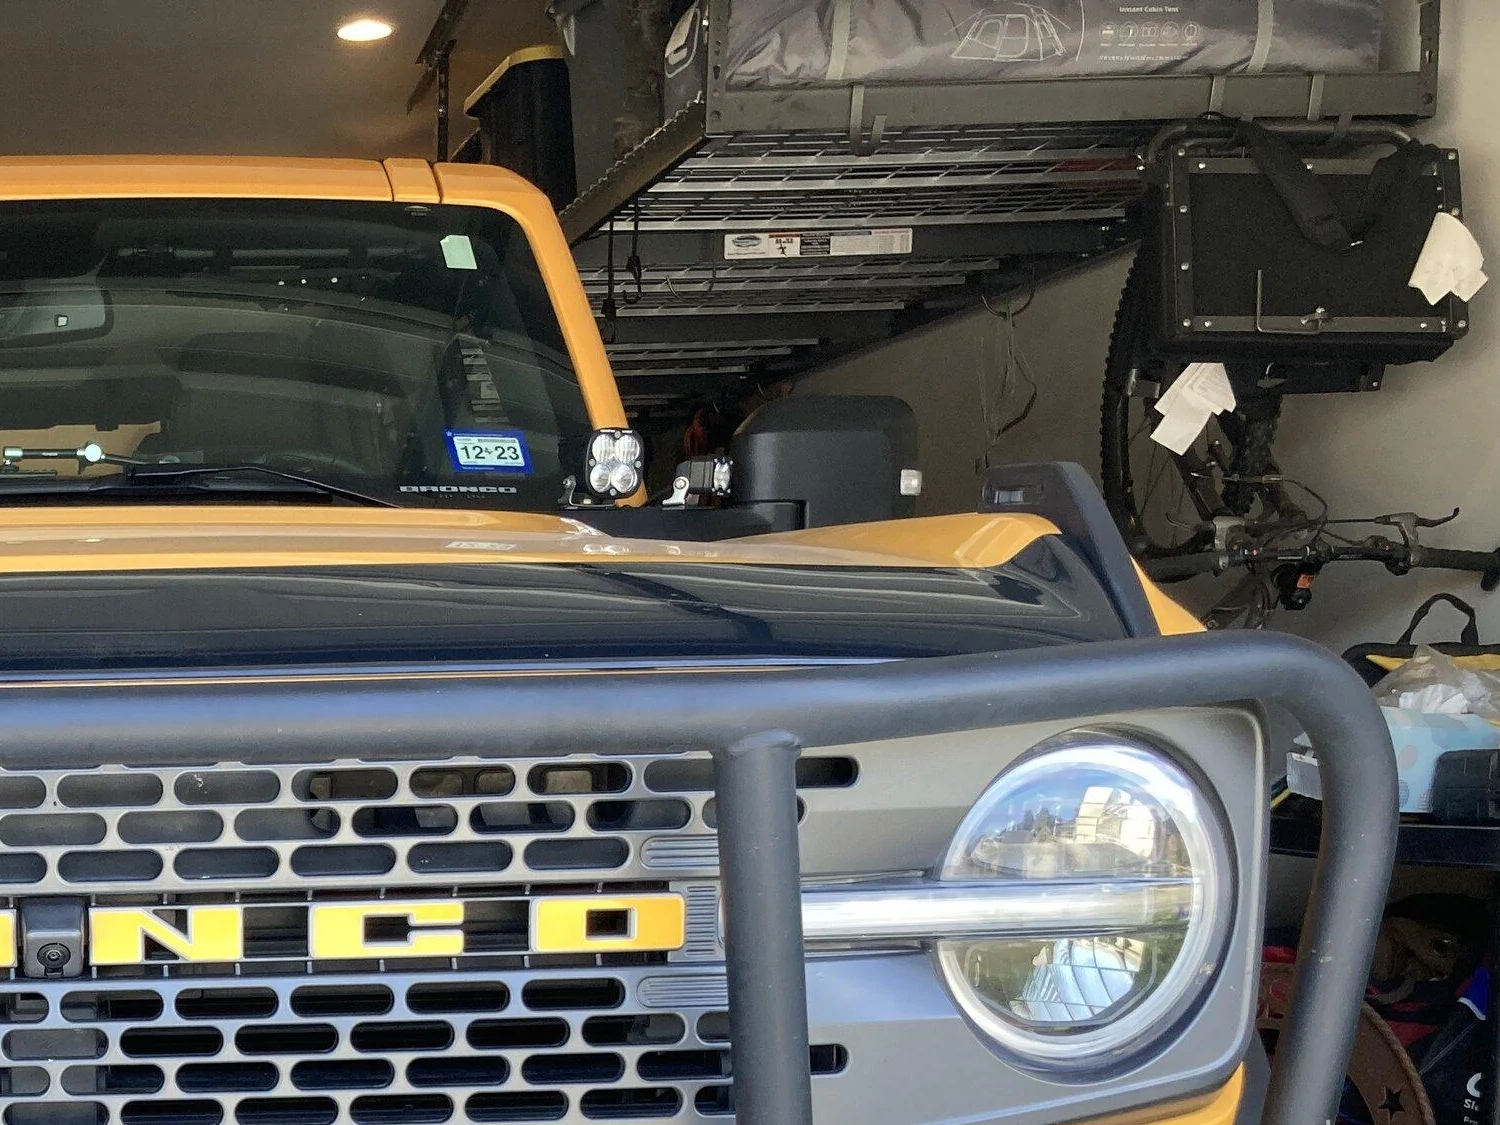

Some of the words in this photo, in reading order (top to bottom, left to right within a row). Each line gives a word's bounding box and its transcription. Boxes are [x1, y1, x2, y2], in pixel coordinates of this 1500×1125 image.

[460, 445, 486, 460] 12
[494, 445, 520, 461] 23
[399, 485, 518, 494] BRONCO
